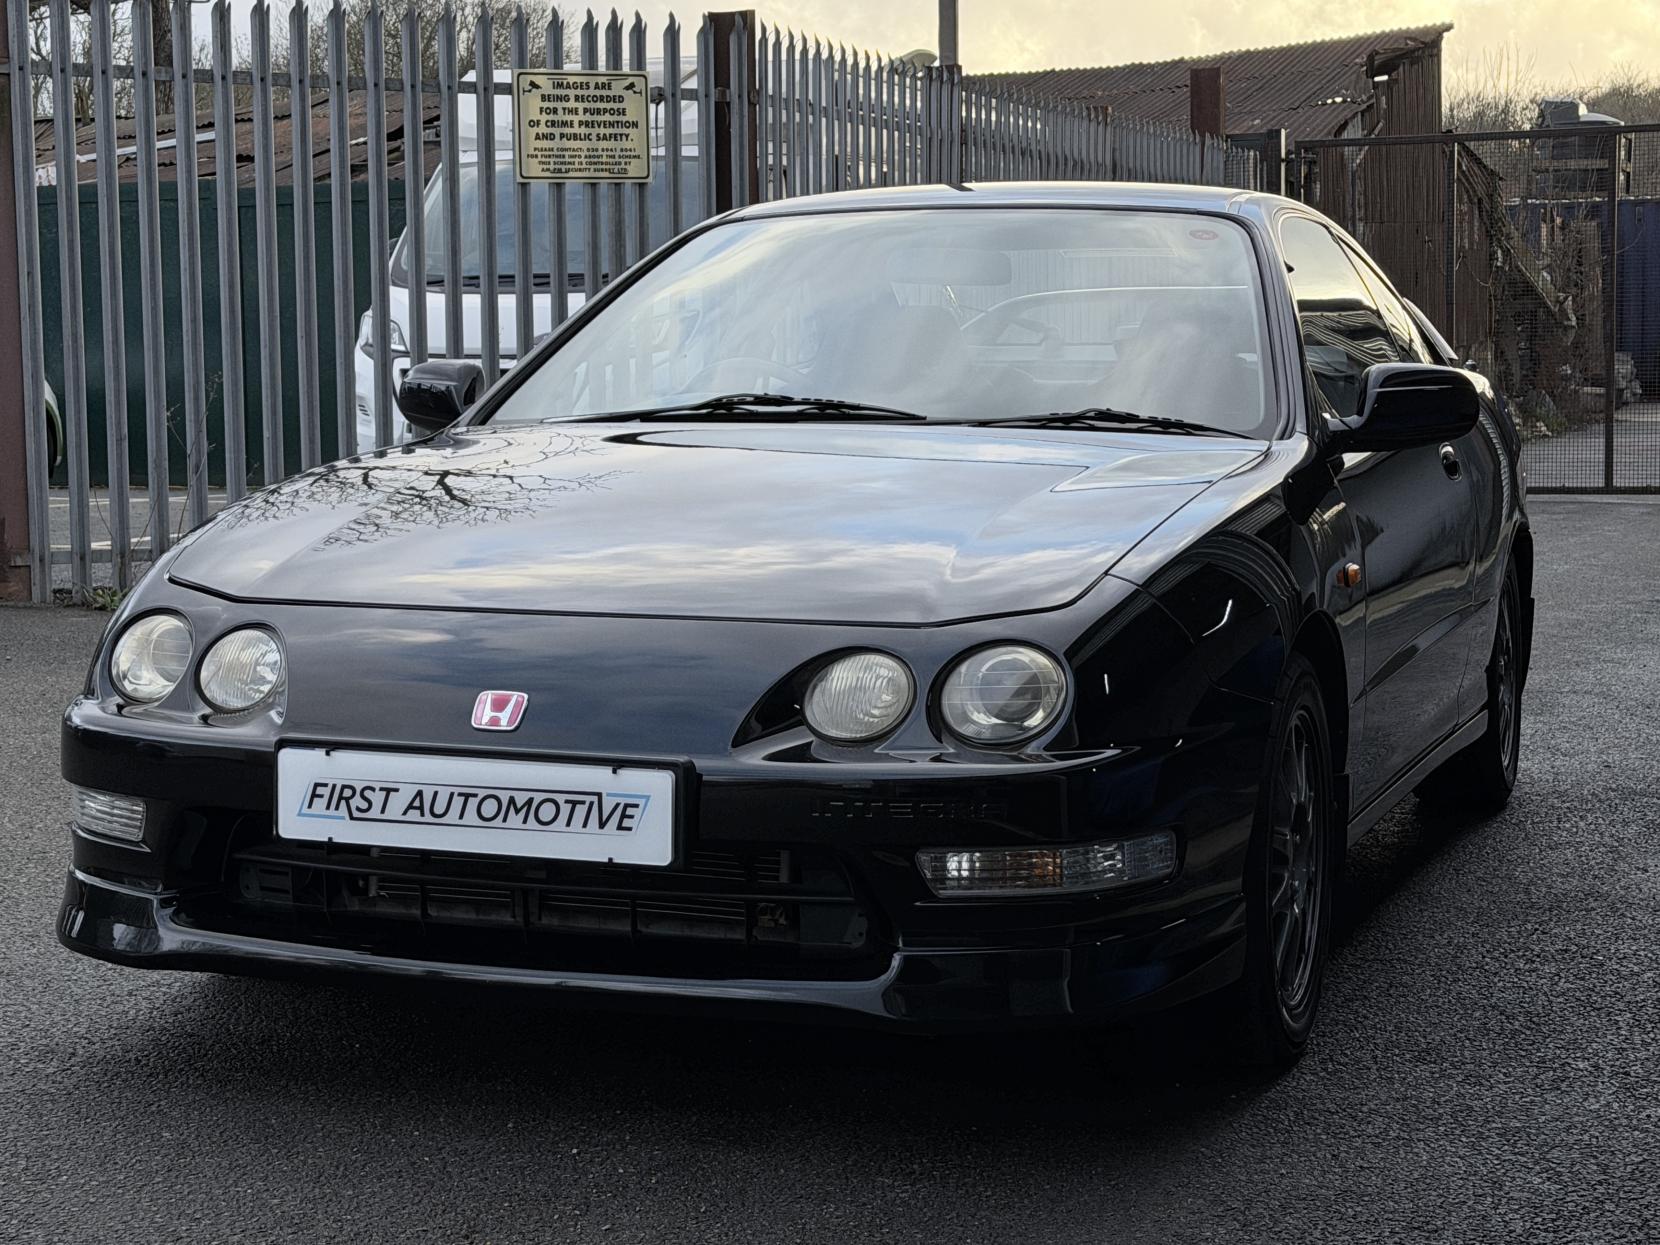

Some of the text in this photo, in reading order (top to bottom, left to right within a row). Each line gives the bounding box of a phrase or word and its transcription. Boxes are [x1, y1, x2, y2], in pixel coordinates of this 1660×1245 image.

[552, 81, 612, 91] IMAGES ARE
[540, 93, 625, 104] BEING RECORDED
[539, 106, 627, 117] FOR THE PURPOSE
[528, 119, 639, 129] OF CRIME PREVENTION
[534, 132, 634, 142] AND PUBLIC SAFETY.
[306, 782, 641, 832] FIRST AUTOMOTIVE
